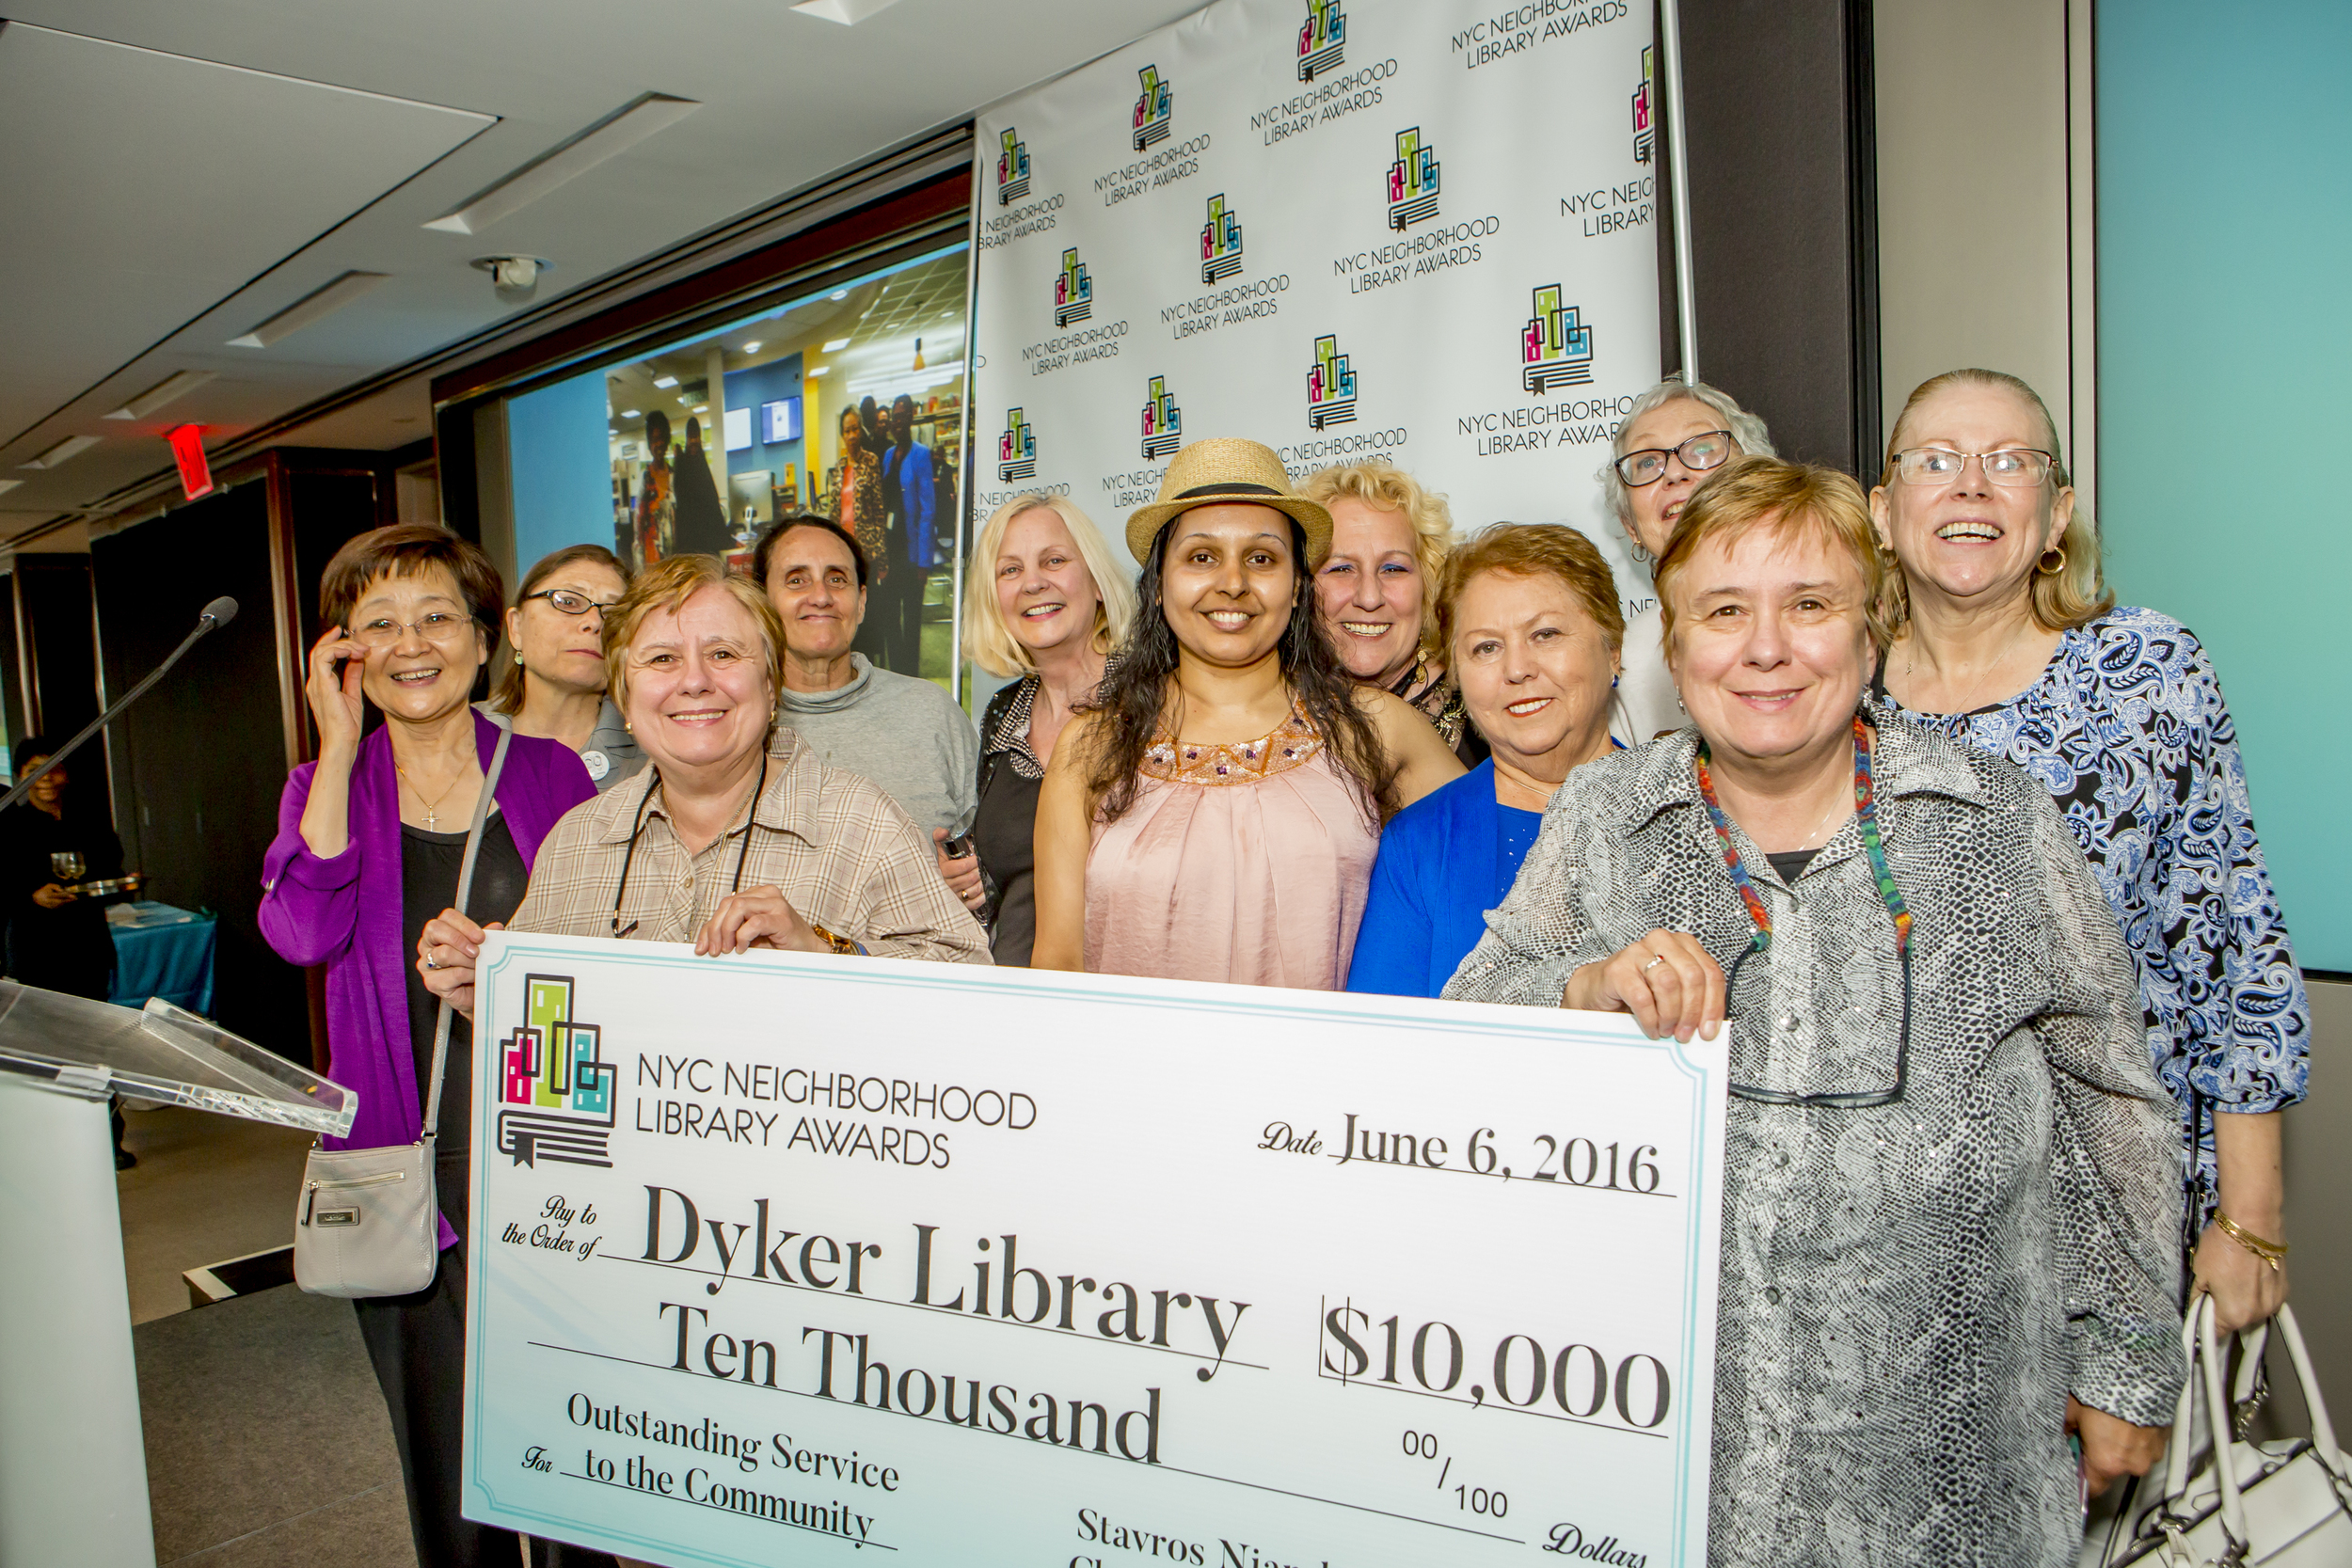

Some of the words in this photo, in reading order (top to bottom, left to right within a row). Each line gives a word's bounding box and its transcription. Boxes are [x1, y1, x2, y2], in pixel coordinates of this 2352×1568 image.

[1452, 23, 1486, 54] NYC
[1490, 0, 1590, 37] NEIGHBO
[1467, 26, 1538, 70] LIBRARY
[1542, 0, 1628, 42] AWARDS
[1251, 106, 1279, 131] NYC
[1281, 58, 1398, 119] NEIGHBORHOOD
[1264, 110, 1317, 147] LIBRARY
[1320, 86, 1383, 125] AWARDS
[1094, 171, 1118, 193] NYC
[1120, 134, 1211, 186] NEIGHBORHOOD
[1104, 177, 1150, 207] LIBRARY
[1152, 158, 1200, 191] AWARDS
[985, 193, 1065, 234] NEIGHBORHOOD
[1013, 214, 1057, 241] AWARDS
[1561, 190, 1607, 217] NYC
[1583, 199, 1655, 237] LIBRARY
[1334, 252, 1368, 277] NYC
[1371, 214, 1501, 267] NEIGHBORHOOD
[1351, 261, 1411, 294] LIBRARY
[1414, 243, 1482, 278] AWARDS
[1160, 304, 1186, 325] NYC
[1187, 274, 1291, 317] NEIGHBORHOOD
[1173, 313, 1219, 341] LIBRARY
[1222, 298, 1279, 327] AWARDS
[1022, 343, 1042, 362] NYC
[1043, 320, 1129, 356] NEIGHBORHOOD
[1031, 351, 1071, 376] LIBRARY
[1072, 341, 1120, 366] AWARDS
[1458, 413, 1498, 436] NYC
[1502, 393, 1645, 430] NEIGHBORHO
[1478, 429, 1552, 456] LIBRARY
[1557, 422, 1621, 448] AWAR
[1293, 427, 1407, 462] NEIGHBORHOOD
[1102, 474, 1126, 492] NYC
[1113, 488, 1158, 508] LIBRARY
[637, 1052, 713, 1094] NYC
[723, 1059, 1038, 1131] NEIGHBORHOOD
[636, 1097, 779, 1148] LIBRARY
[787, 1117, 951, 1170] AWARDS
[1257, 1121, 1323, 1156] Date
[1337, 1113, 1449, 1165] June
[1466, 1128, 1513, 1183] 6,
[1532, 1134, 1661, 1194] 2016
[539, 1195, 577, 1228] Pay
[580, 1202, 597, 1226] to
[501, 1223, 526, 1246] the
[529, 1223, 575, 1257] Order
[578, 1235, 602, 1262] of
[641, 1184, 882, 1296] Dyker
[909, 1223, 1252, 1383] Library
[660, 1302, 779, 1390] Ten
[803, 1326, 1163, 1465] Thousand
[1323, 1295, 1672, 1430] $10,000
[566, 1392, 763, 1473] Outstanding
[771, 1433, 900, 1494] Service
[520, 1444, 553, 1476] For
[585, 1449, 616, 1484] to
[626, 1453, 675, 1496] the
[684, 1468, 875, 1549] Community
[1077, 1508, 1204, 1566] Stavros
[1542, 1522, 1647, 1568] Dollars
